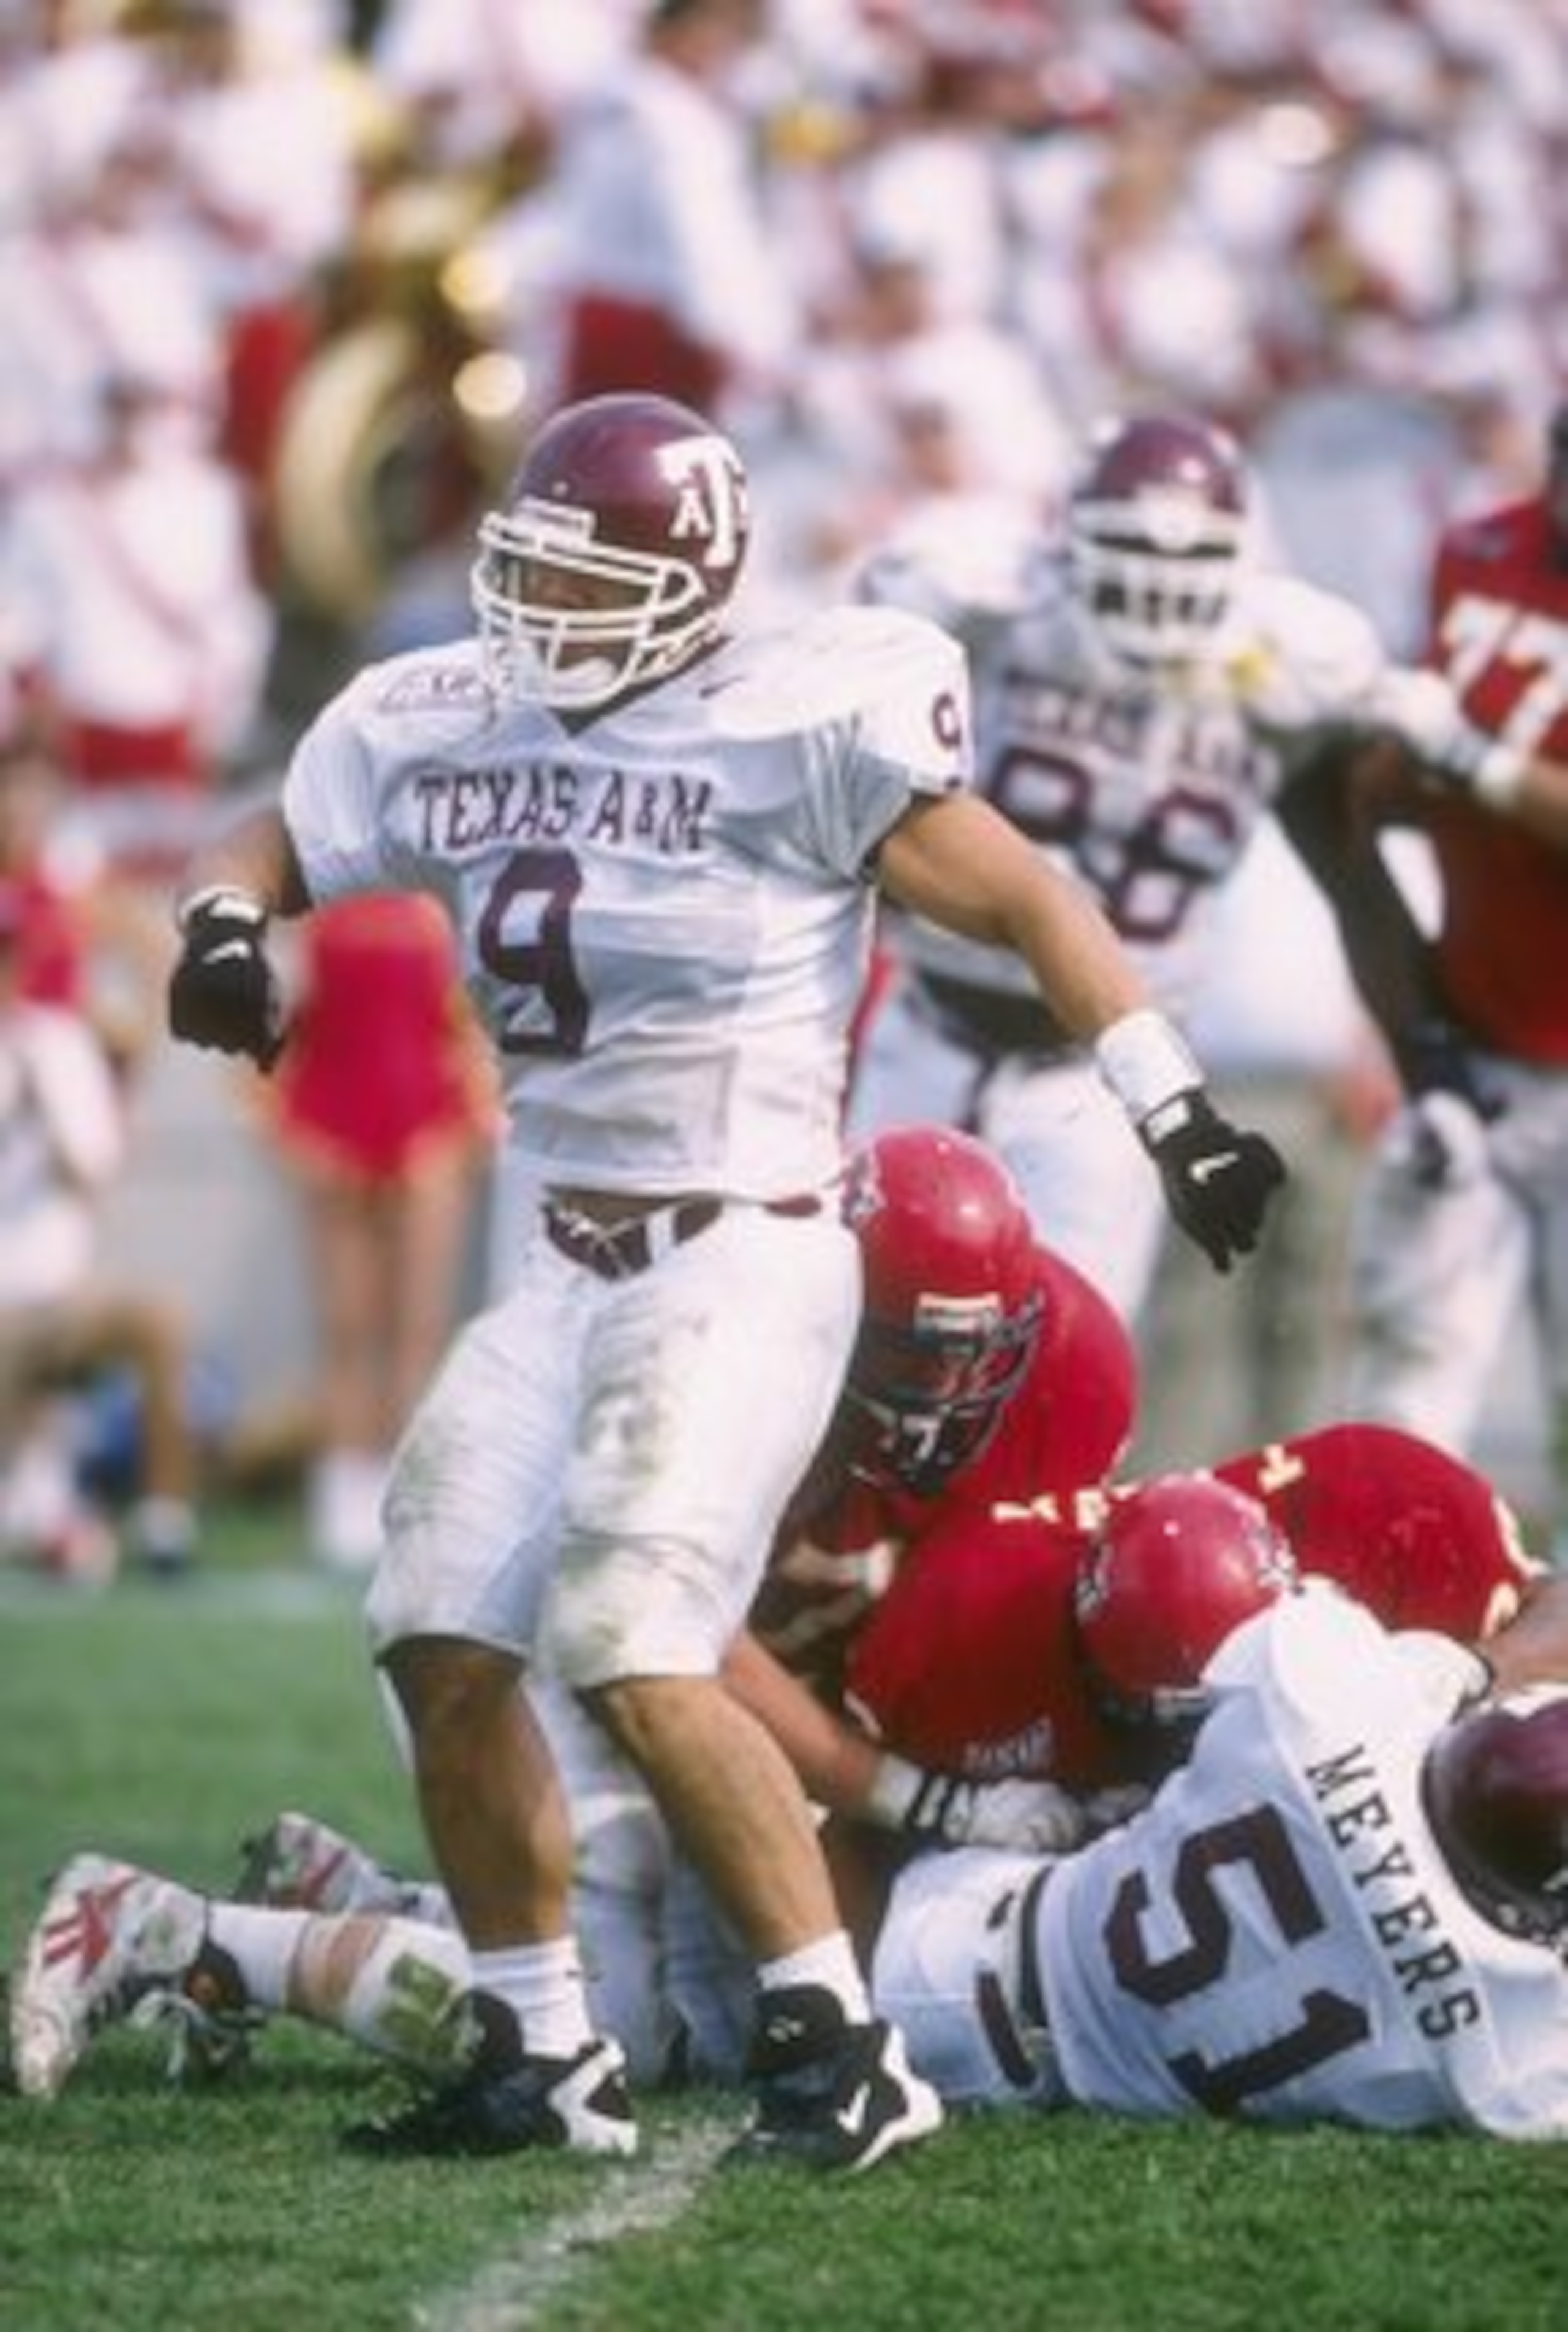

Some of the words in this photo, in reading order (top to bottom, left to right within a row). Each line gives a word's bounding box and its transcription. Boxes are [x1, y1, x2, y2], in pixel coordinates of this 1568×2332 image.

[415, 766, 579, 851] TEXAS
[589, 769, 712, 853] A&M
[478, 848, 592, 1058] 9
[1104, 1802, 1372, 2119] 51
[1306, 1745, 1481, 2041] MEYERS
